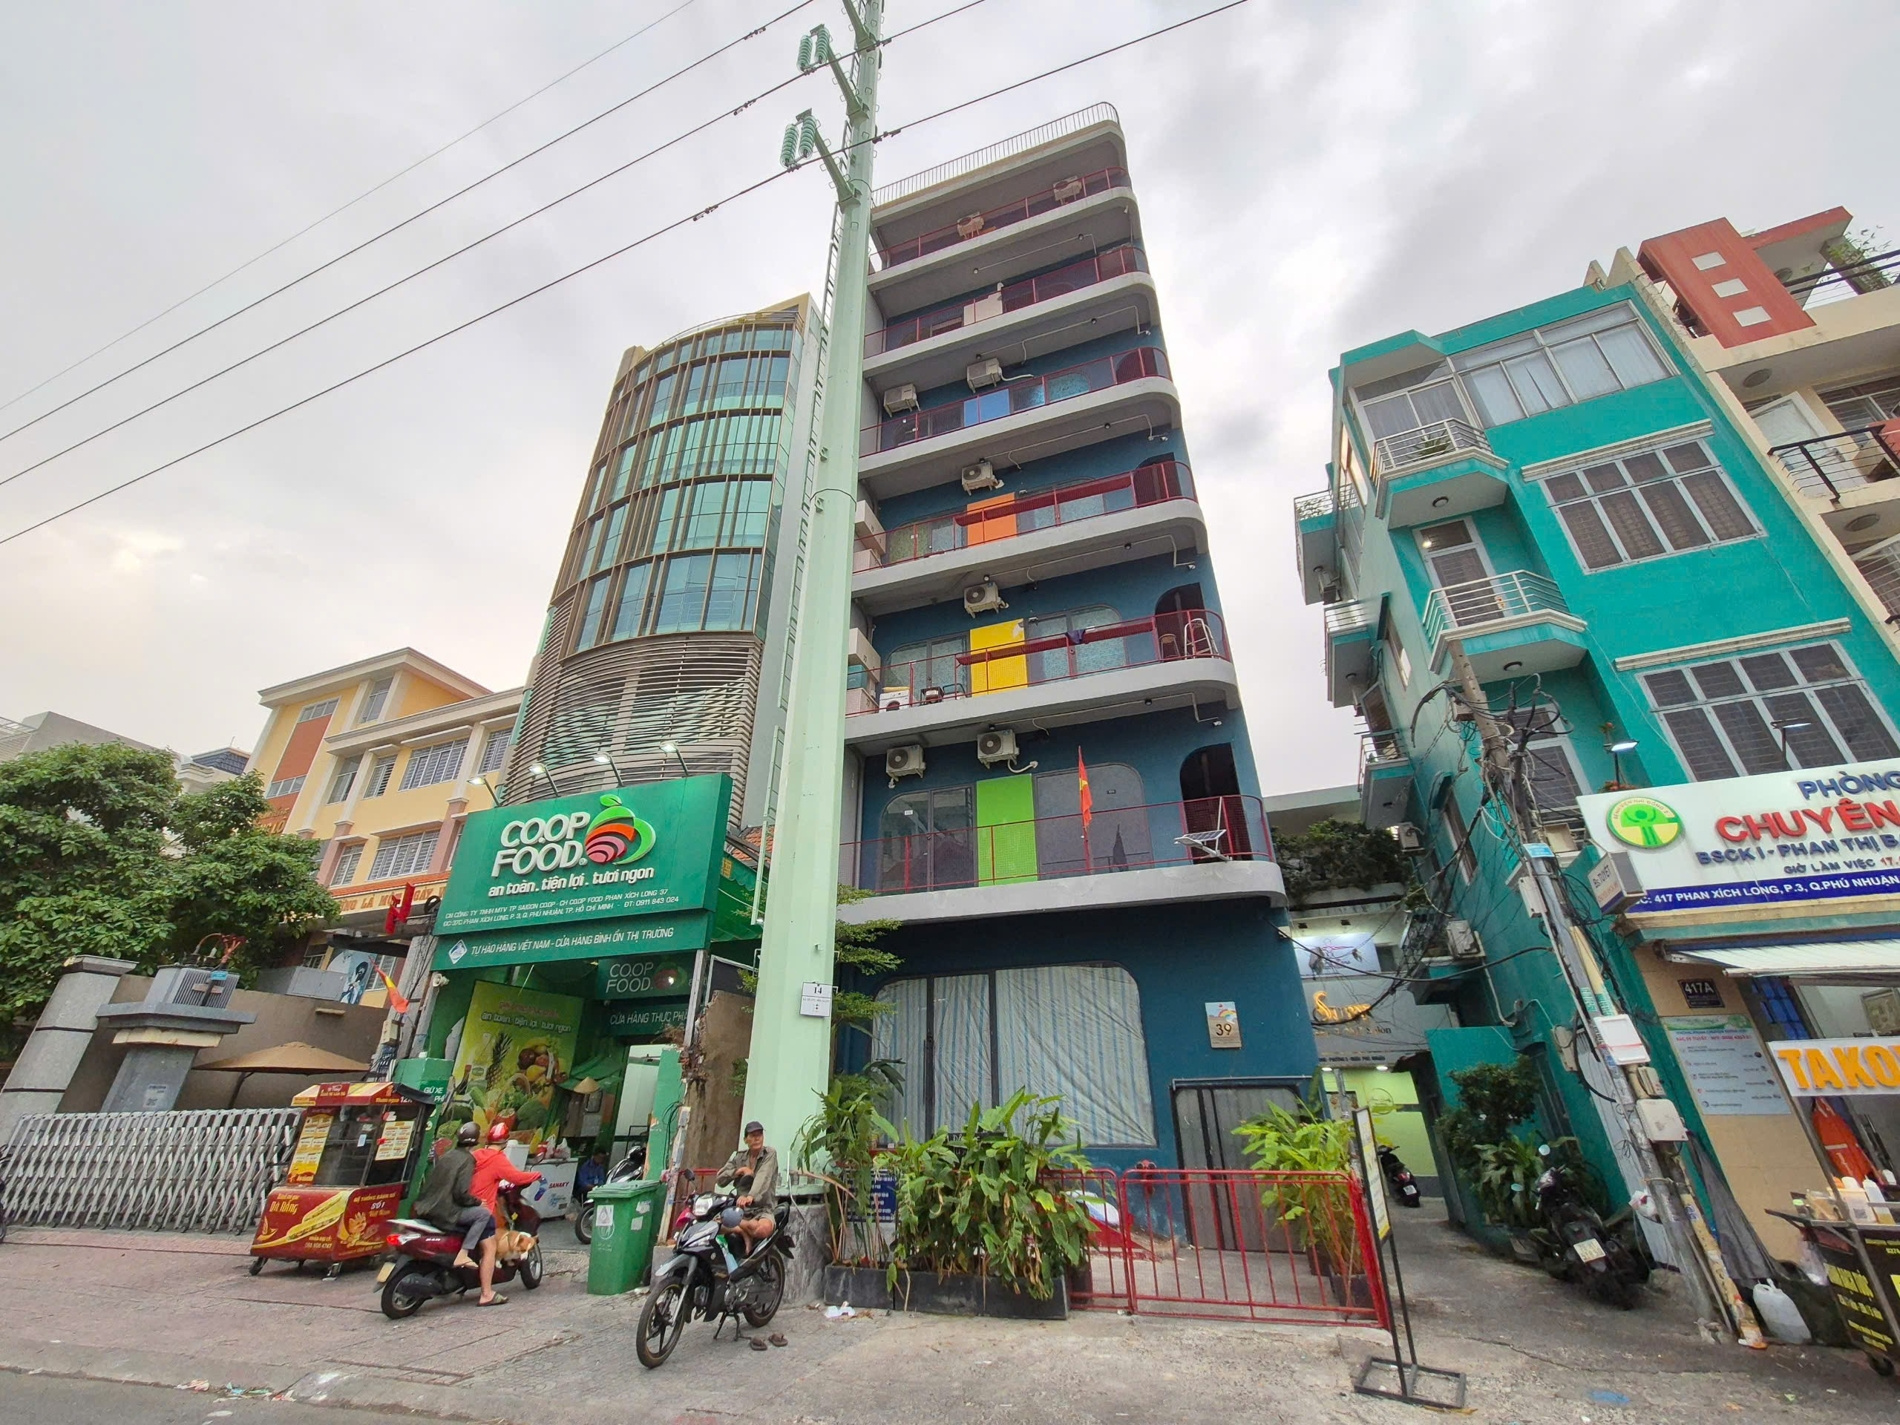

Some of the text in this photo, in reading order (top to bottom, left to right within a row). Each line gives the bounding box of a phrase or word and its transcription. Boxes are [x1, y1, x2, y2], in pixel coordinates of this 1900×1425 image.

[1716, 798, 1900, 842] CHUYÊN
[1696, 847, 1756, 865] BSCK
[1776, 840, 1839, 858] PHAN
[1841, 835, 1881, 853] THỊ
[1880, 833, 1900, 848] B
[1784, 863, 1807, 874] GIỜ
[1811, 860, 1841, 872] LÀM
[1844, 858, 1876, 870] VIỆC
[488, 886, 504, 897] an
[541, 876, 567, 894] tiện
[592, 870, 619, 885] tươi
[620, 867, 655, 884] ngon
[1655, 894, 1673, 903] 417
[1675, 891, 1710, 902] PHAN
[1711, 888, 1741, 899] XÍCH
[1743, 885, 1784, 896] LONG,
[1784, 884, 1808, 893] P.3,
[1809, 877, 1850, 891] Q.PHÚ
[1852, 875, 1900, 887] NHUẬN
[575, 904, 585, 913] HỒ
[585, 904, 597, 912] CHÍ
[651, 897, 664, 905] 843
[665, 896, 679, 904] 024
[624, 891, 639, 899] XÍCH
[471, 946, 481, 956] TỰ
[481, 943, 497, 954] HÀO
[497, 941, 516, 953] HÀNG
[518, 939, 532, 952] VIỆT
[533, 940, 551, 949] NAM
[555, 935, 570, 948] CỬA
[571, 932, 593, 946] HÀNG
[594, 931, 611, 944] BÌNH
[626, 930, 639, 942] THỊ
[642, 927, 674, 940] TRƯỜNG
[813, 986, 823, 995] 14
[1684, 982, 1715, 994] 417A
[482, 1012, 492, 1020] an
[555, 1024, 572, 1034] ngon
[610, 1014, 626, 1025] CỬA
[626, 1010, 649, 1024] HÀNG
[1215, 1023, 1232, 1036] 39
[1777, 1045, 1900, 1090] TAKO
